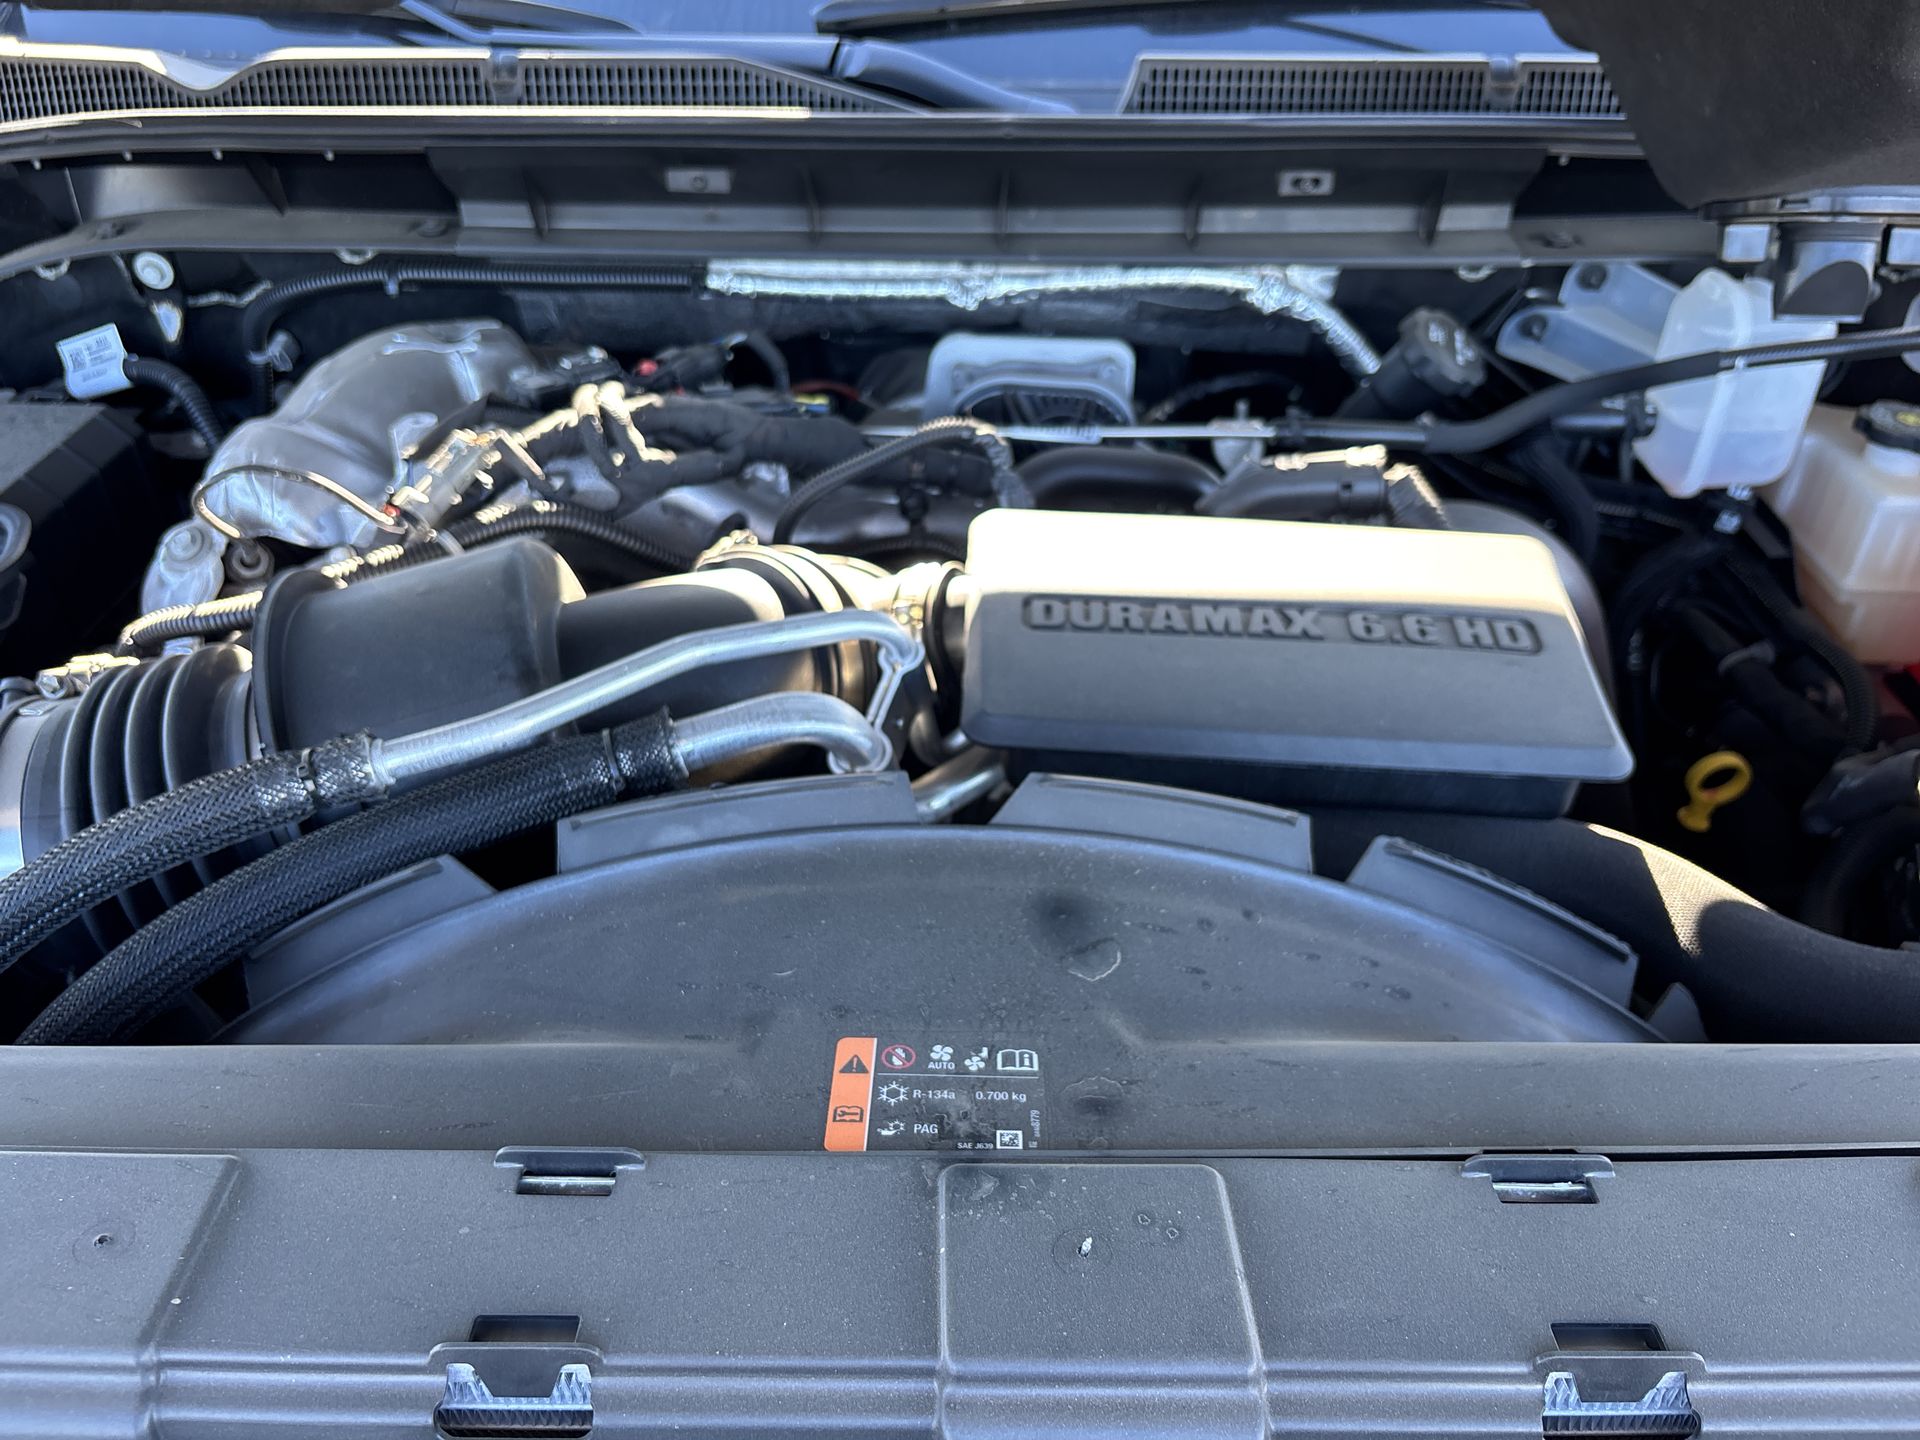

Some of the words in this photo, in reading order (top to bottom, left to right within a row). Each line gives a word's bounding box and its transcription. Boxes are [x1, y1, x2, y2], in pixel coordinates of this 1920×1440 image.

[1028, 598, 1325, 641] DURAMAX
[1346, 610, 1439, 647] 6.6
[1453, 614, 1538, 653] HD
[927, 1062, 956, 1070] AUTO
[912, 1090, 956, 1100] R-134a
[975, 1091, 1009, 1101] 0.700
[1011, 1091, 1027, 1103] kg
[913, 1124, 938, 1134] PAG
